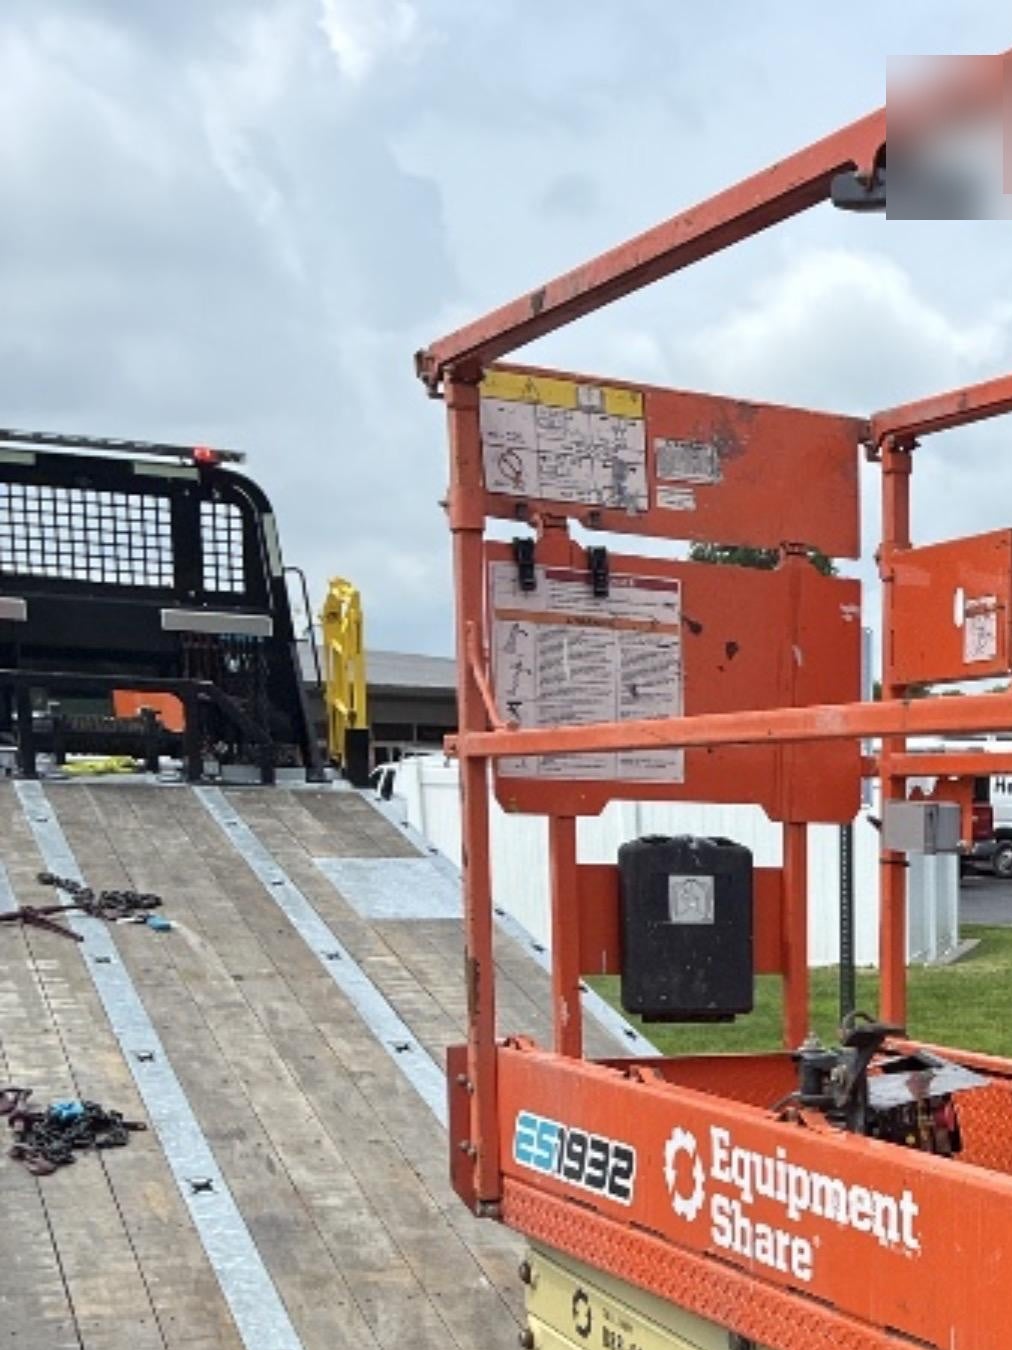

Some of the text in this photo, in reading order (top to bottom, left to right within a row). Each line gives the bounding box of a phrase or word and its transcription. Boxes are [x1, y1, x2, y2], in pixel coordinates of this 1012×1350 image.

[512, 1111, 635, 1205] ES1932
[710, 1125, 921, 1252] Equipment
[710, 1192, 813, 1283] Share
